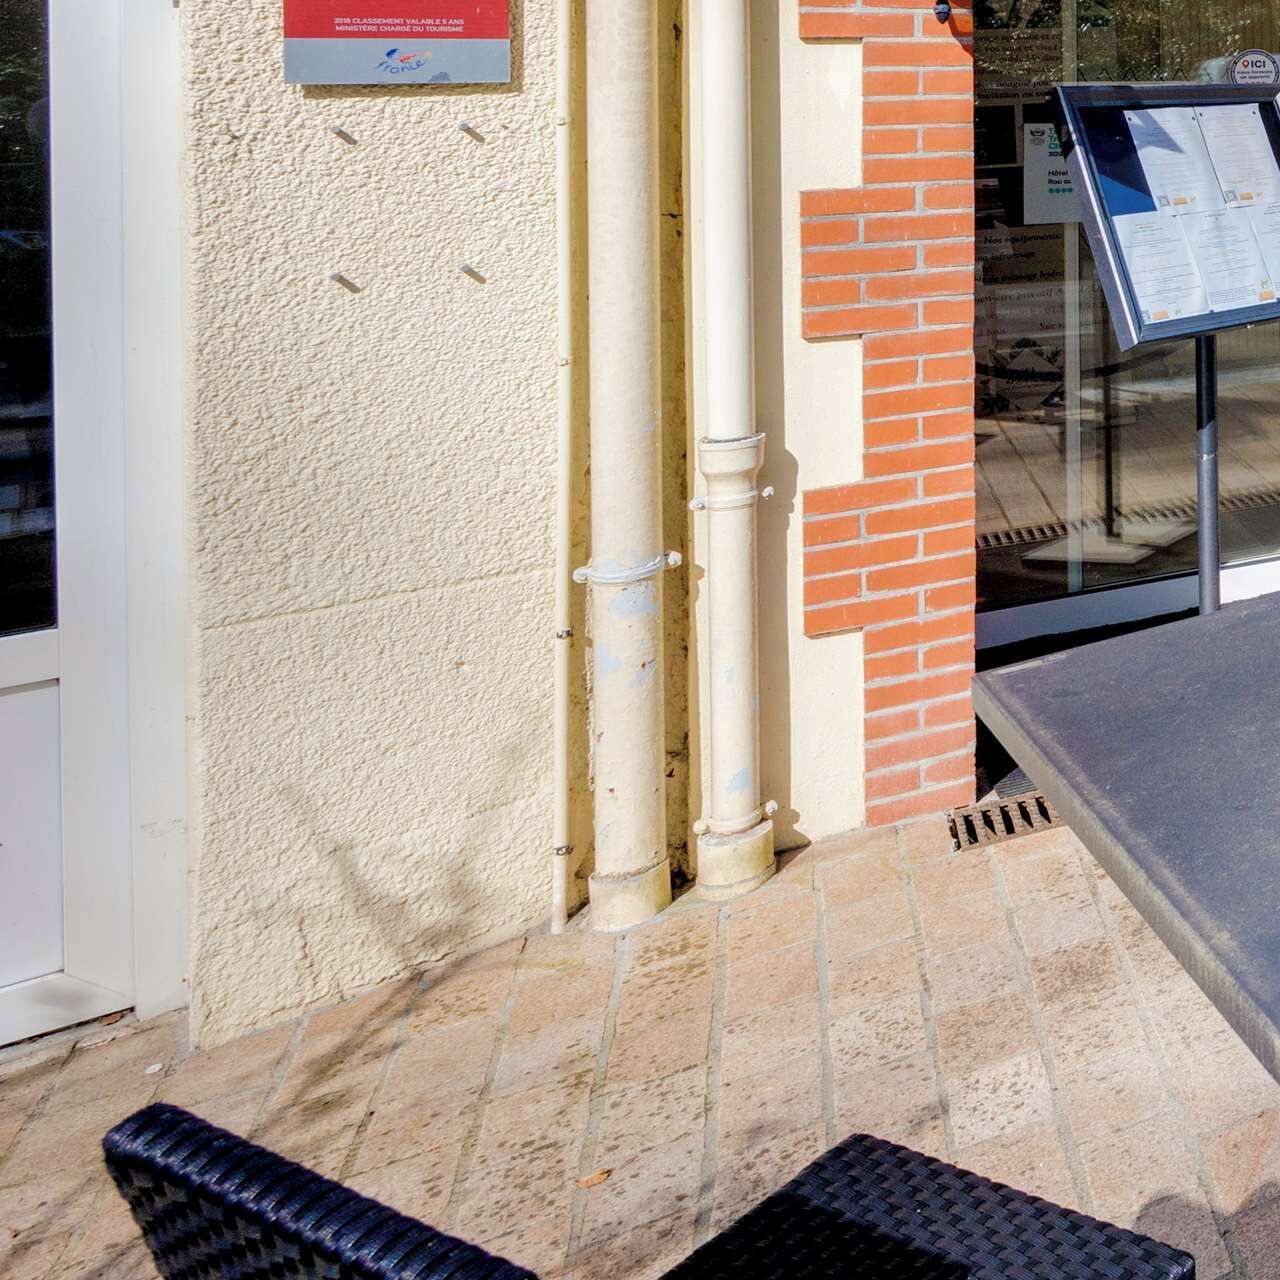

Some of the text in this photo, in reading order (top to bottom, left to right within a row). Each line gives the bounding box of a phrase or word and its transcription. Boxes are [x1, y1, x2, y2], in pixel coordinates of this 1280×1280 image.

[351, 17, 404, 25] CLASSEMENT
[413, 24, 424, 32] DU
[426, 24, 464, 32] TOURISME
[1251, 59, 1266, 68] ICI
